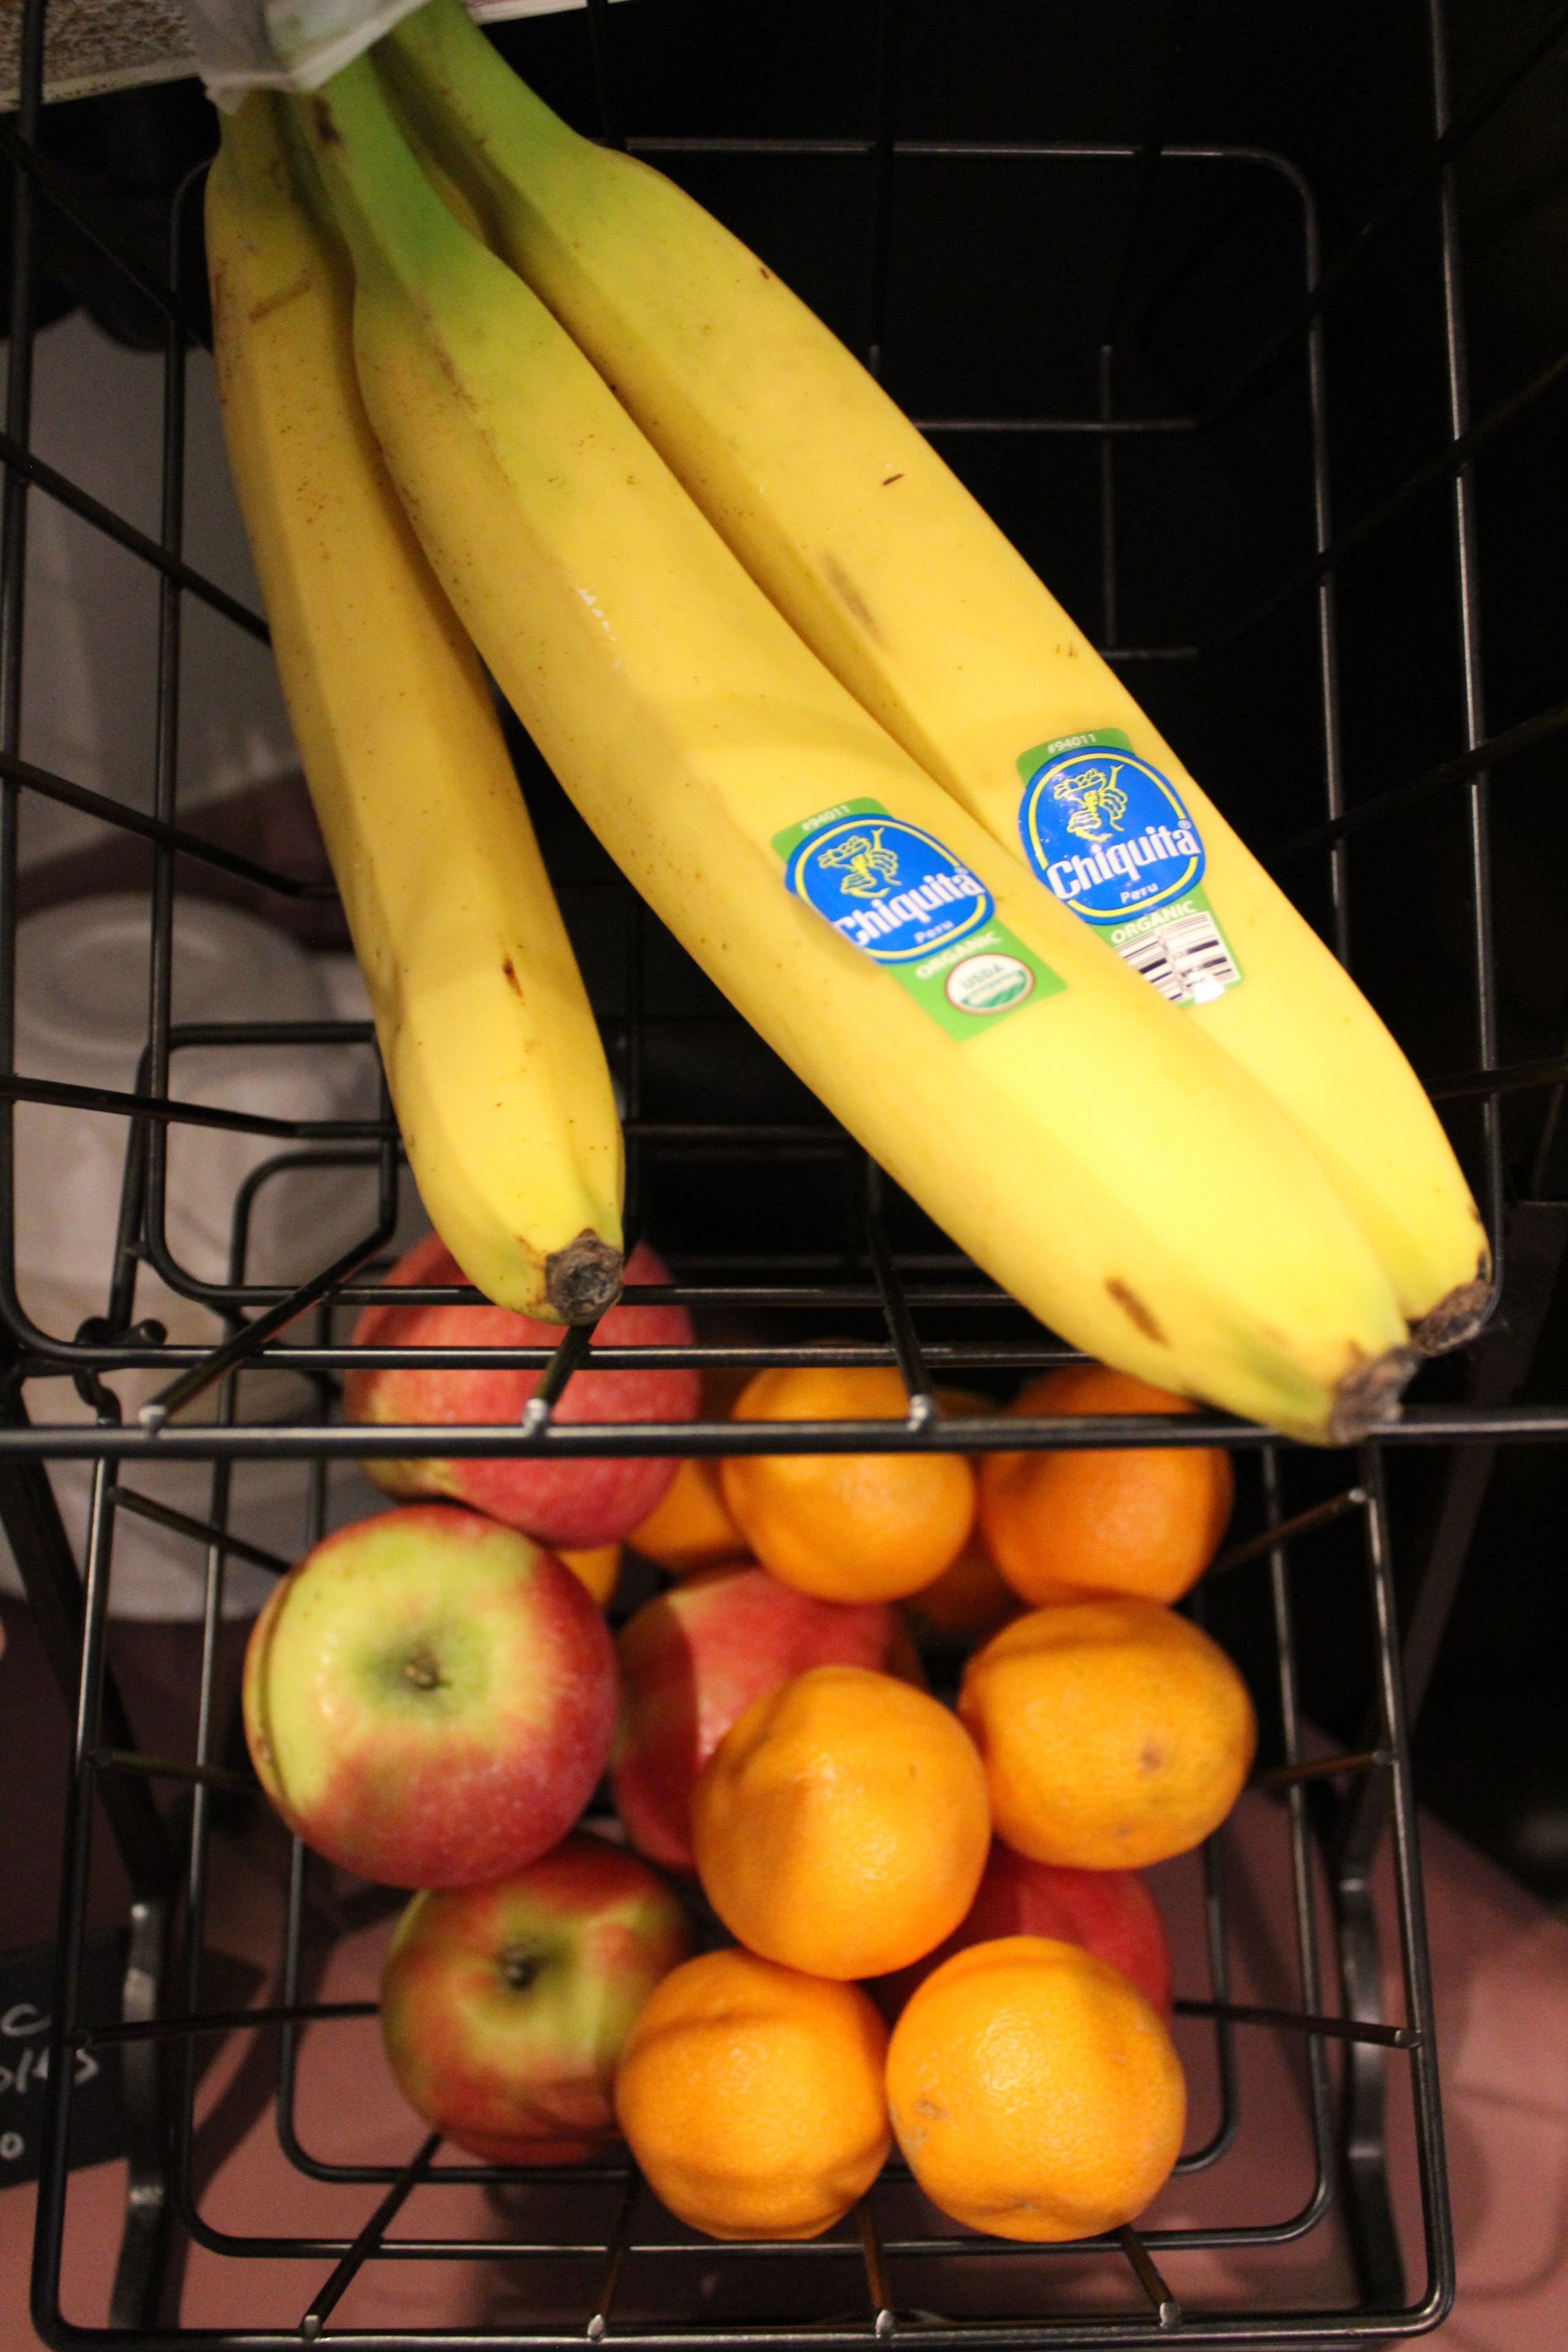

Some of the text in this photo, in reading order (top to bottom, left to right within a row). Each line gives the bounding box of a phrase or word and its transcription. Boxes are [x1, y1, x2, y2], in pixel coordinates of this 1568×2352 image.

[1047, 734, 1096, 754] #94011
[1047, 825, 1200, 899] Chiquita
[1120, 882, 1159, 903] Peru
[914, 921, 954, 943] Peru
[1111, 900, 1197, 944] ORGANIC
[916, 931, 1002, 979] ORGANIC
